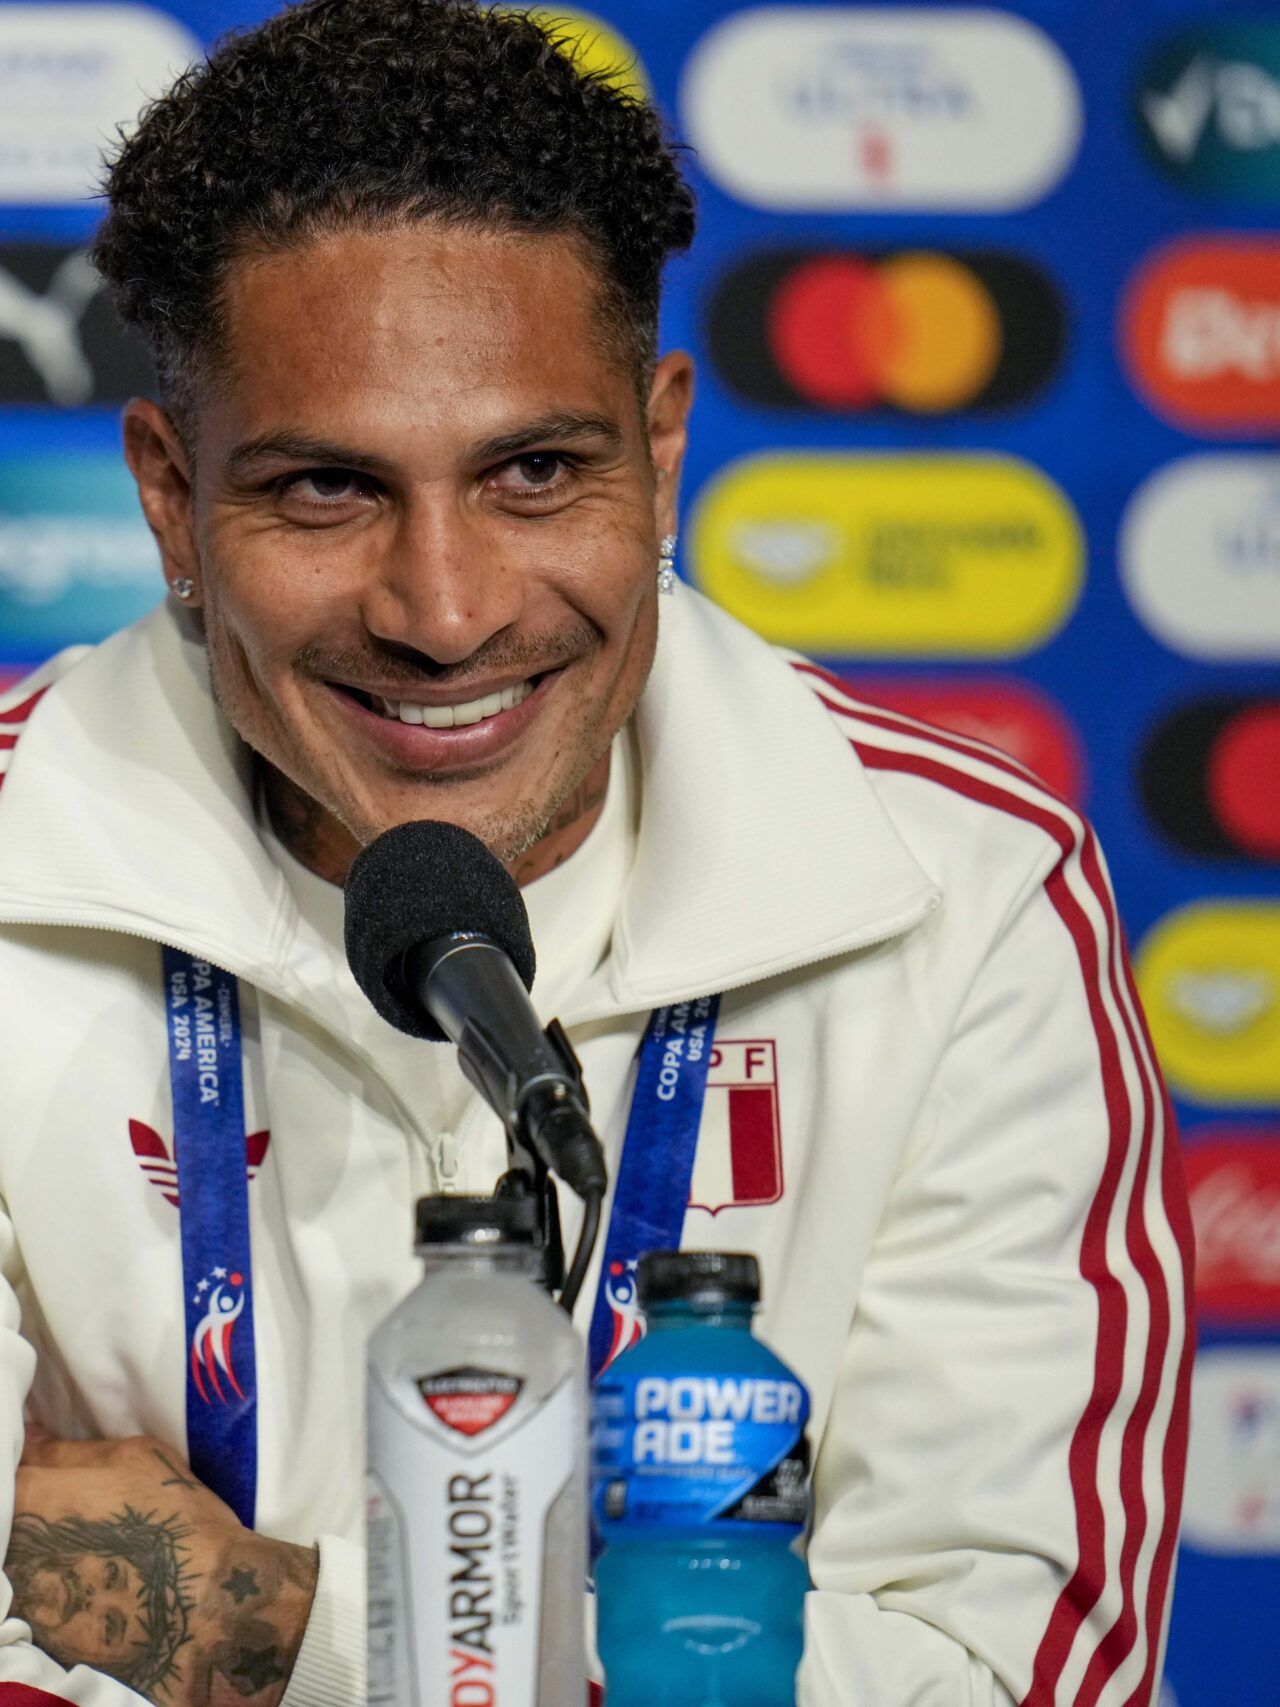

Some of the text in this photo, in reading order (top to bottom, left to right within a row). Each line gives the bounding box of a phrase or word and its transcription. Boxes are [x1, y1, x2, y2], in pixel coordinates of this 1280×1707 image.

[171, 972, 192, 1061] USA 2024
[192, 961, 220, 1104] PA AMERICA
[686, 995, 711, 1062] USA 20
[656, 1037, 684, 1101] COPA
[745, 1047, 766, 1079] F
[635, 1376, 802, 1424] POWER
[632, 1420, 737, 1464] ADE
[448, 1473, 496, 1707] DYARMOR
